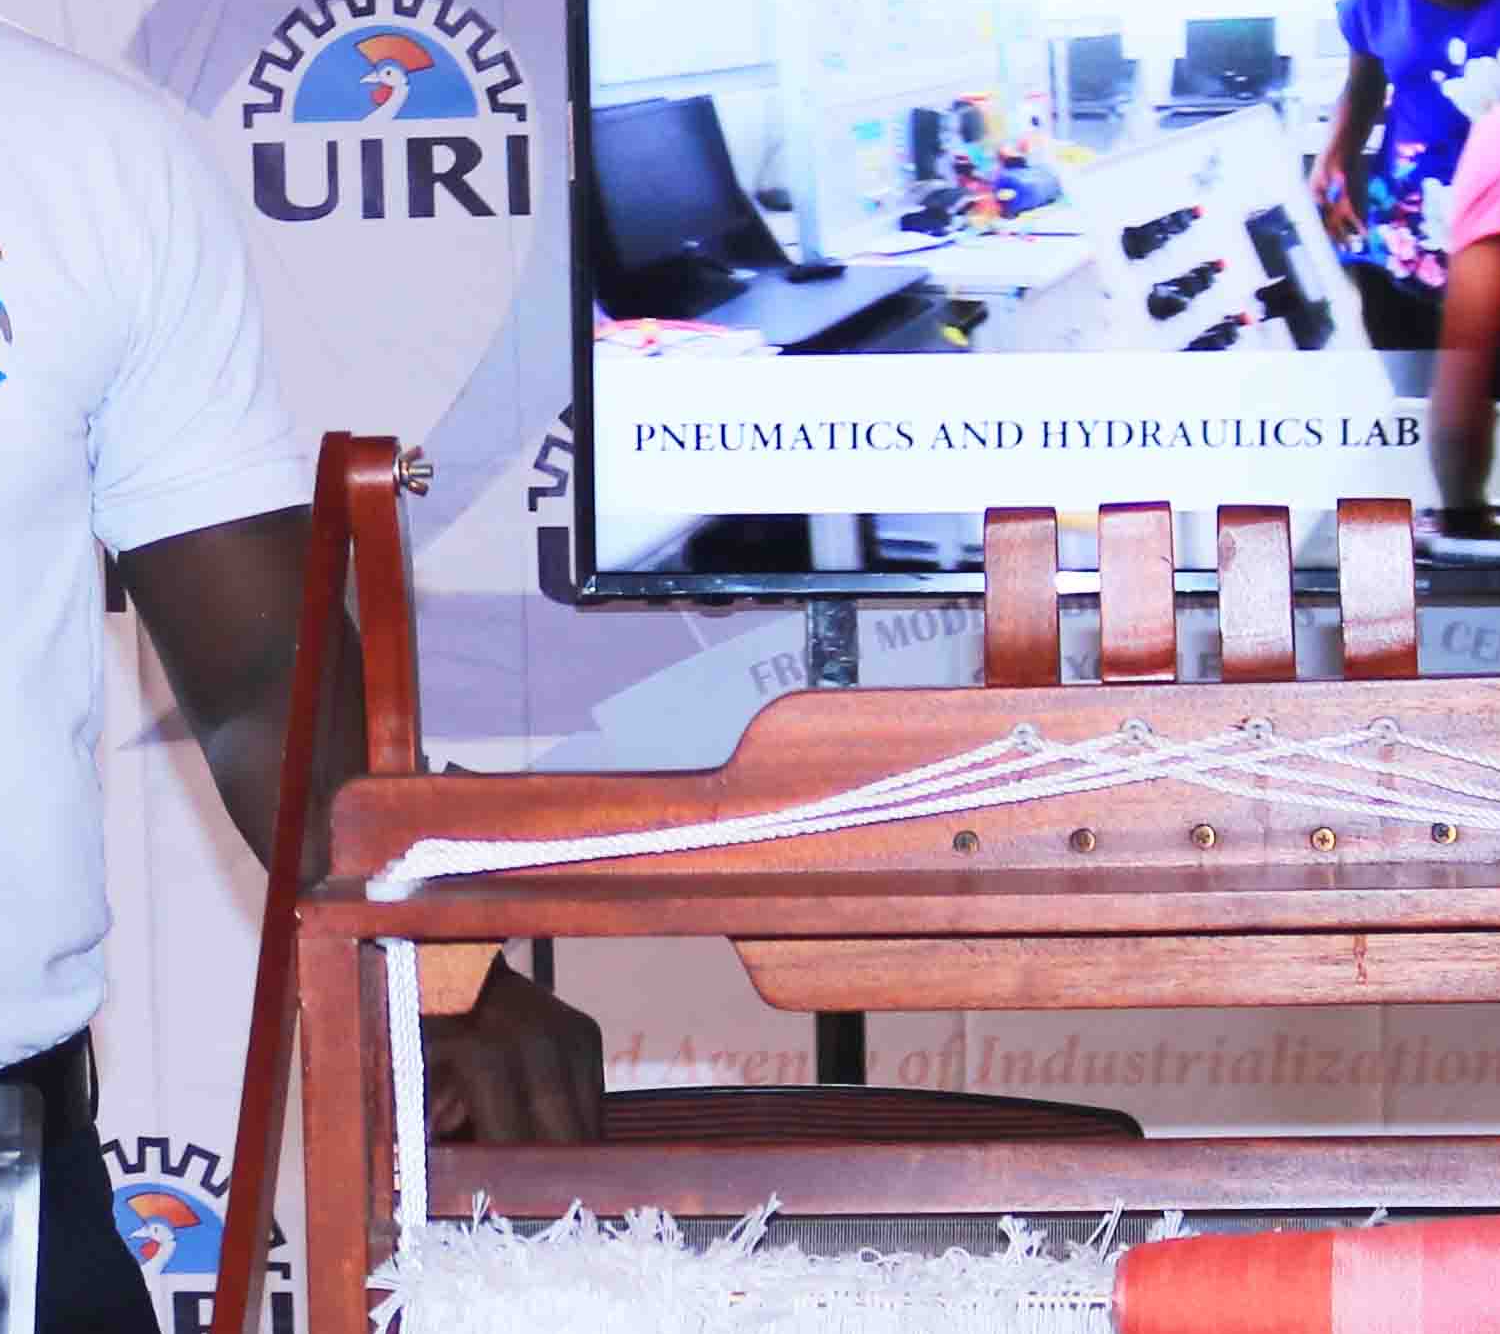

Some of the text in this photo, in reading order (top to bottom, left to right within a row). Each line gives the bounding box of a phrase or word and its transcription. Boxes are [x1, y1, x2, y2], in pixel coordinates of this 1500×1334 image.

[252, 135, 531, 222] UIRI
[636, 417, 1420, 451] PNEUMATICS AND HYDRAULICS LAB
[900, 1027, 965, 1095] of
